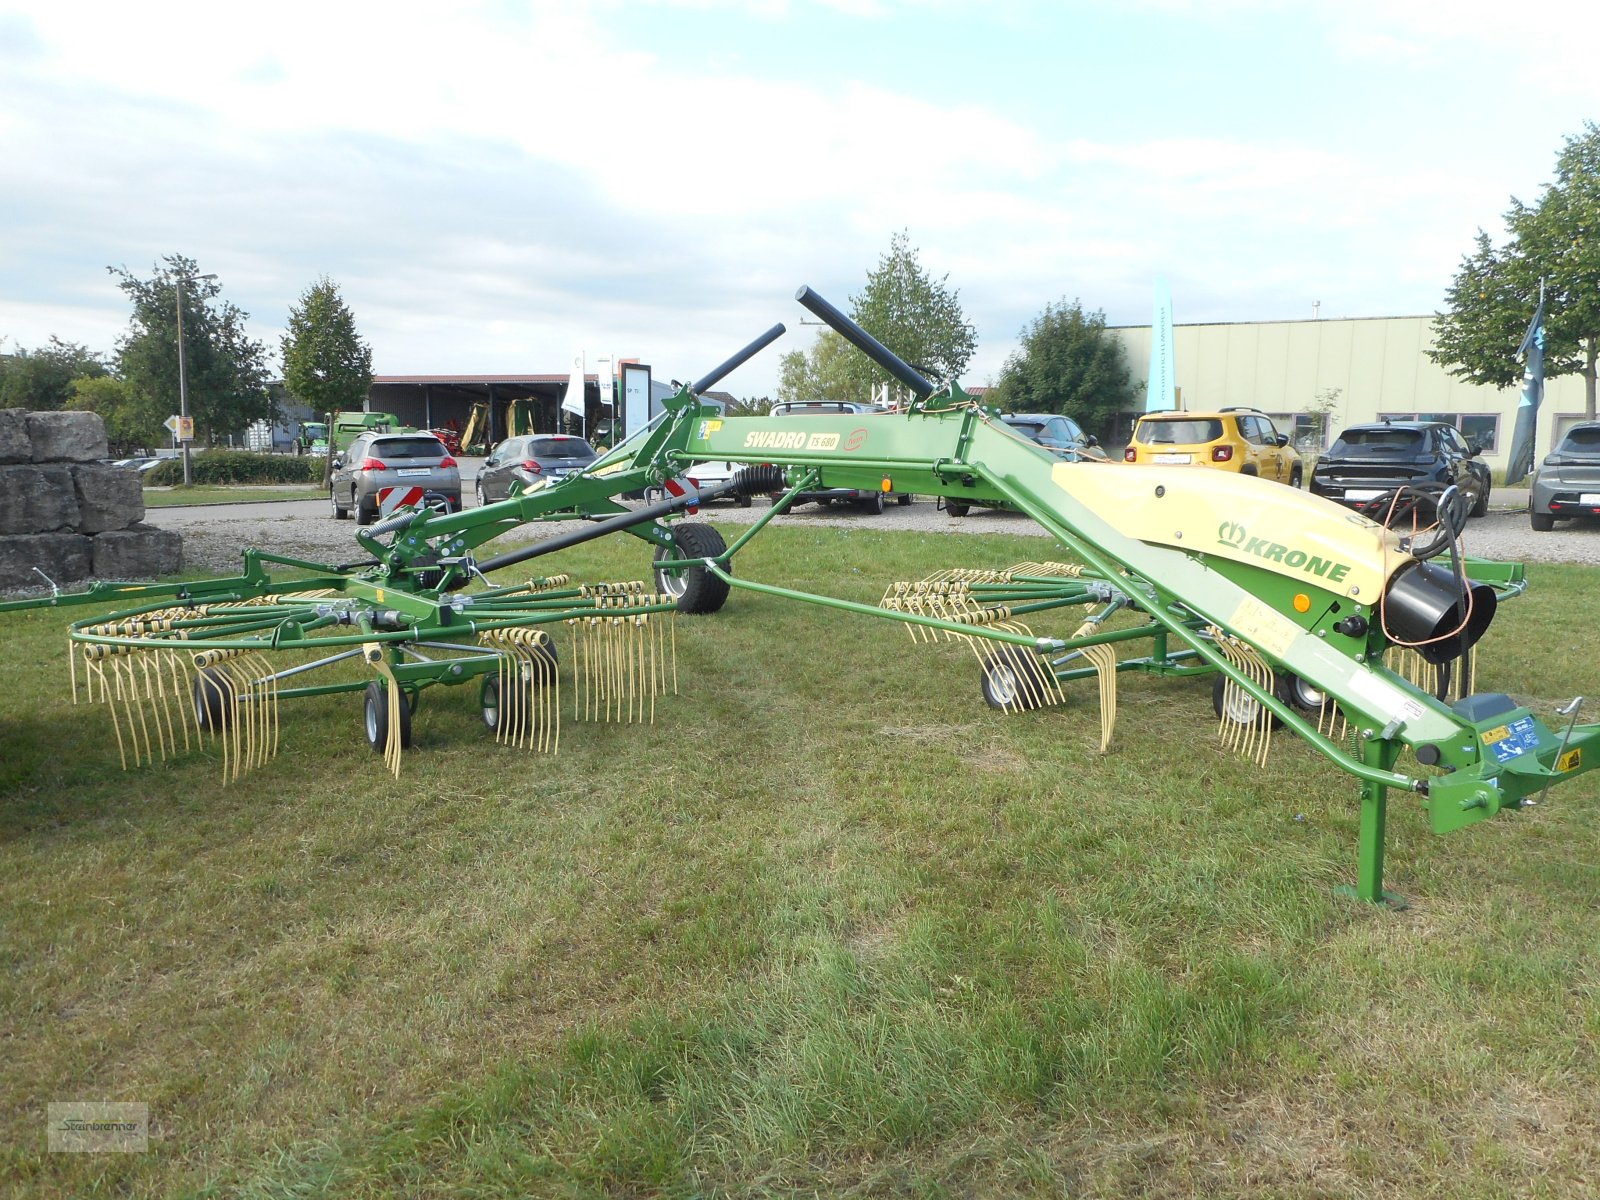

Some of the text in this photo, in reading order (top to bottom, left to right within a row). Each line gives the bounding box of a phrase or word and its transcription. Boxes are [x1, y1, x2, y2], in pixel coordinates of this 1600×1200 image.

[744, 431, 836, 448] SWADRO TS 680
[1243, 536, 1351, 583] KRONE
